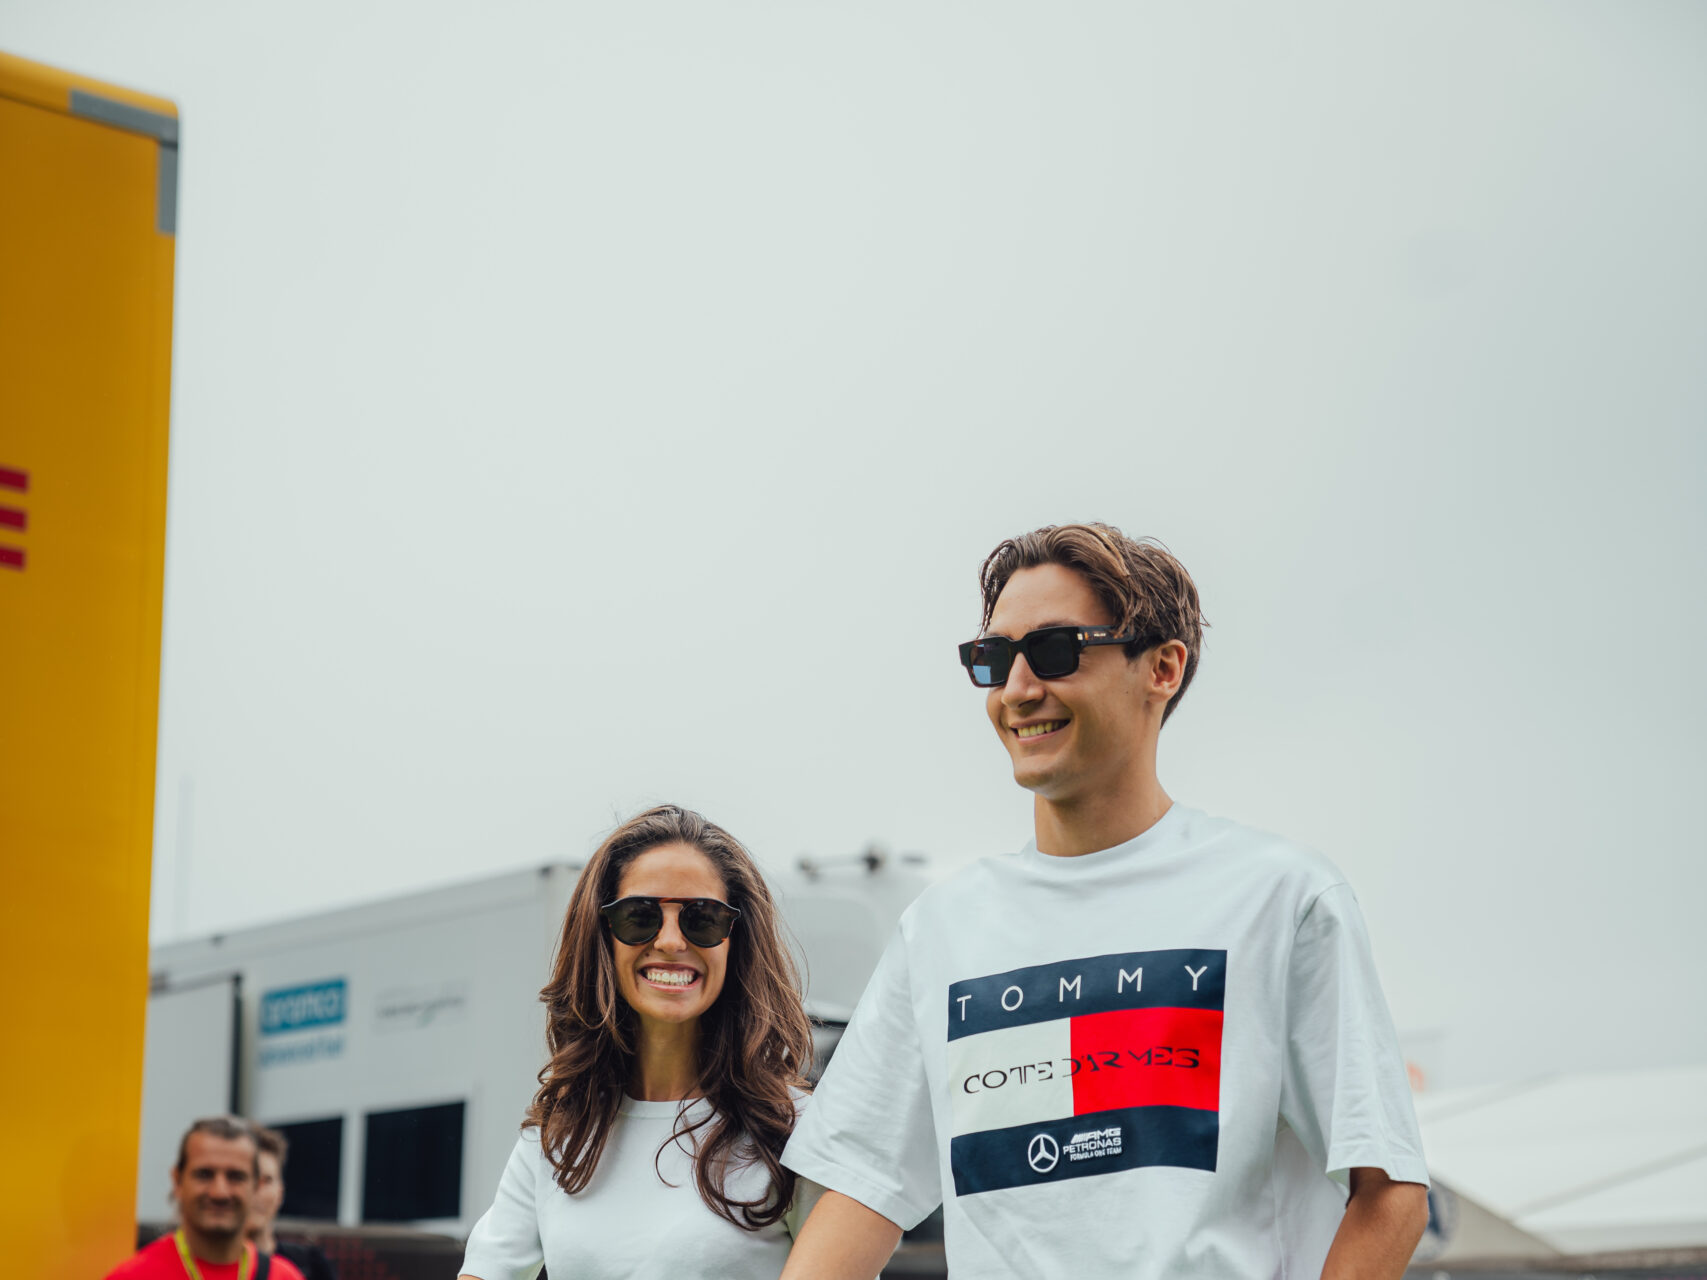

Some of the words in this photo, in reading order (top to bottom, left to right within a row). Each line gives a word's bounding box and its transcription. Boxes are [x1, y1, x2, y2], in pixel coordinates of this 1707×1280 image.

[957, 965, 1207, 1021] TOMMY
[963, 1061, 1053, 1094] COTE
[1063, 1137, 1122, 1155] PETRONAS
